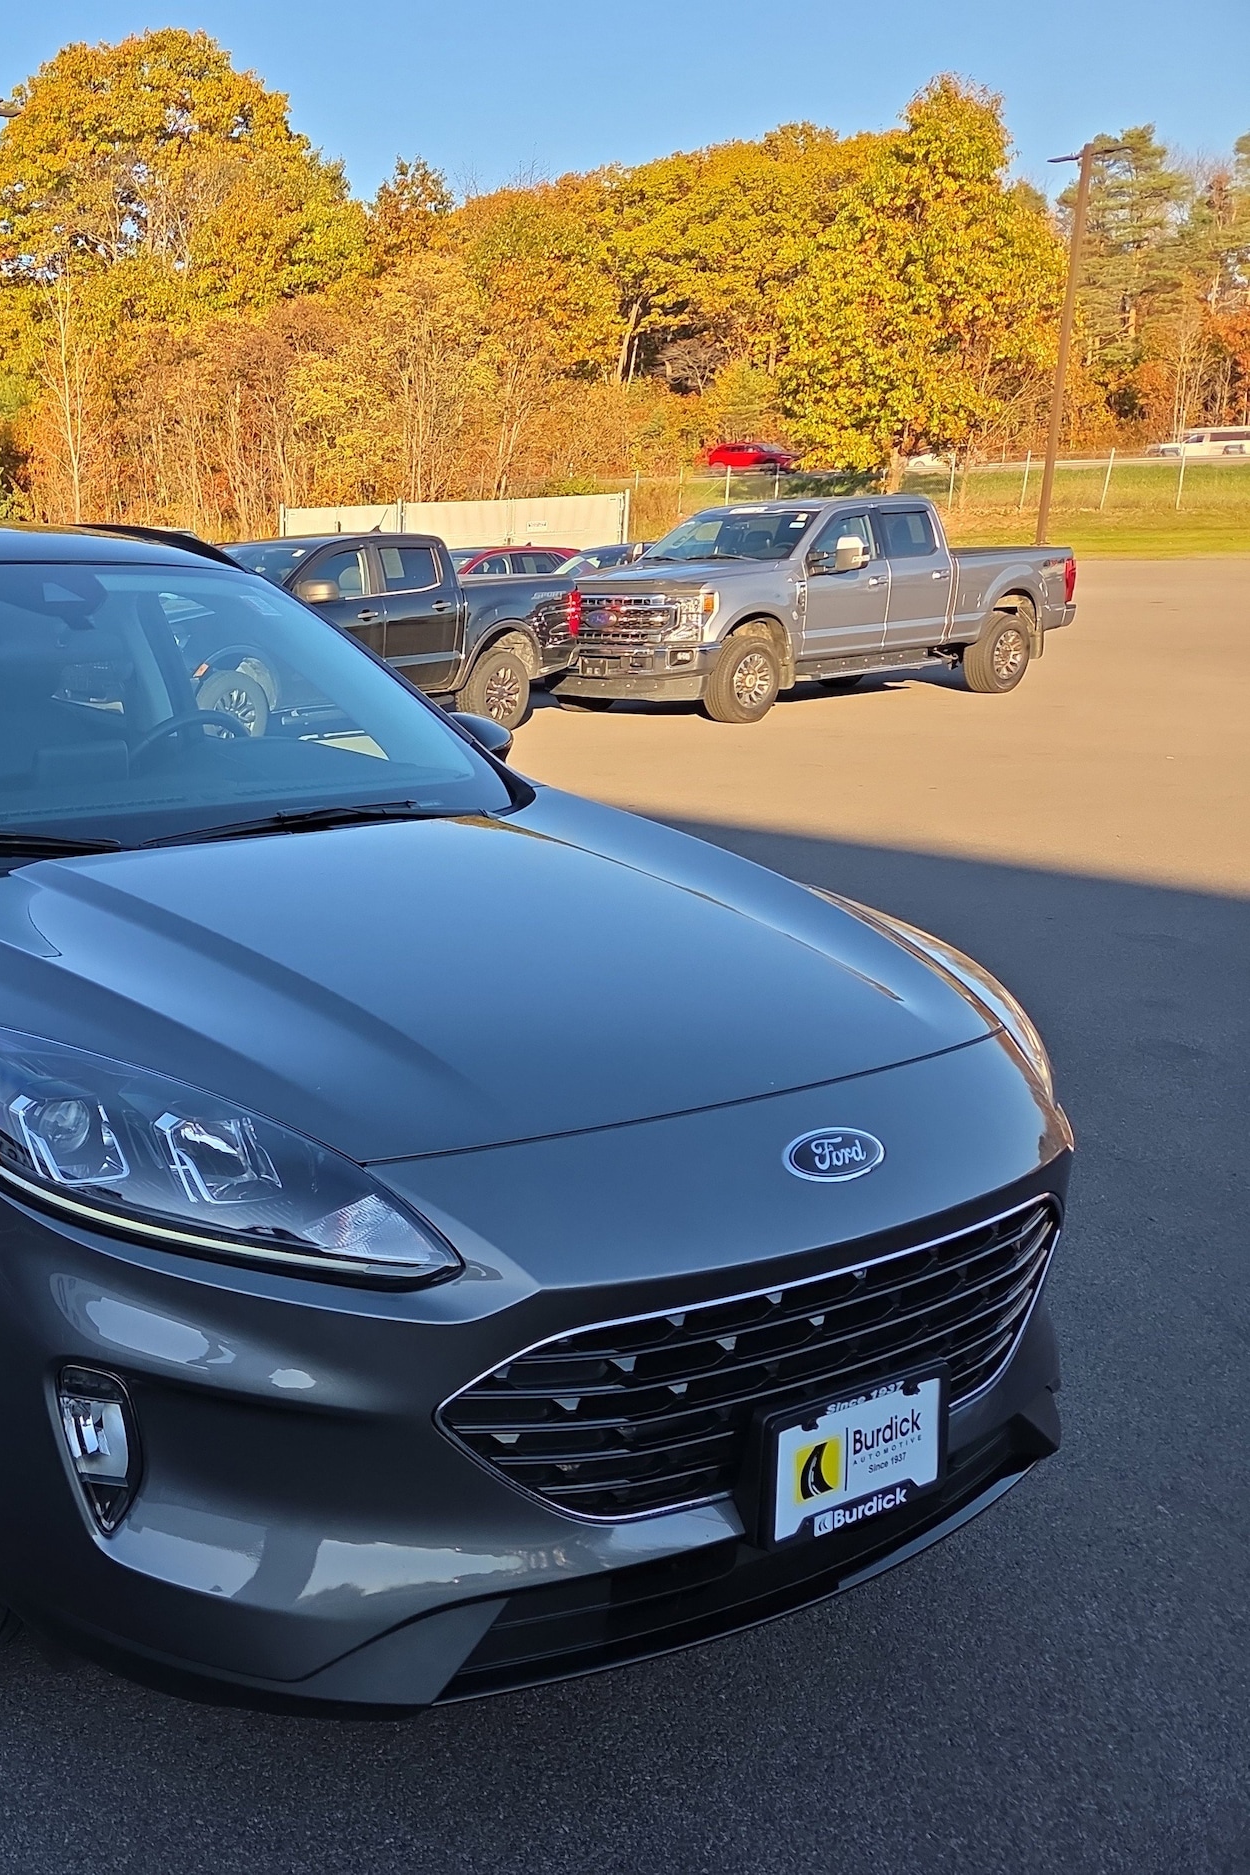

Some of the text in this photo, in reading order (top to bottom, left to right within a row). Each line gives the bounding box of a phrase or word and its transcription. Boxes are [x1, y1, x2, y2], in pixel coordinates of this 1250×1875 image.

[810, 1136, 867, 1170] Ford
[826, 1381, 905, 1415] Since 1937
[852, 1408, 922, 1456] Burdick
[852, 1434, 923, 1466] AUTOMOTIVE
[868, 1451, 907, 1474] Since 1937
[833, 1487, 907, 1529] Burdick
